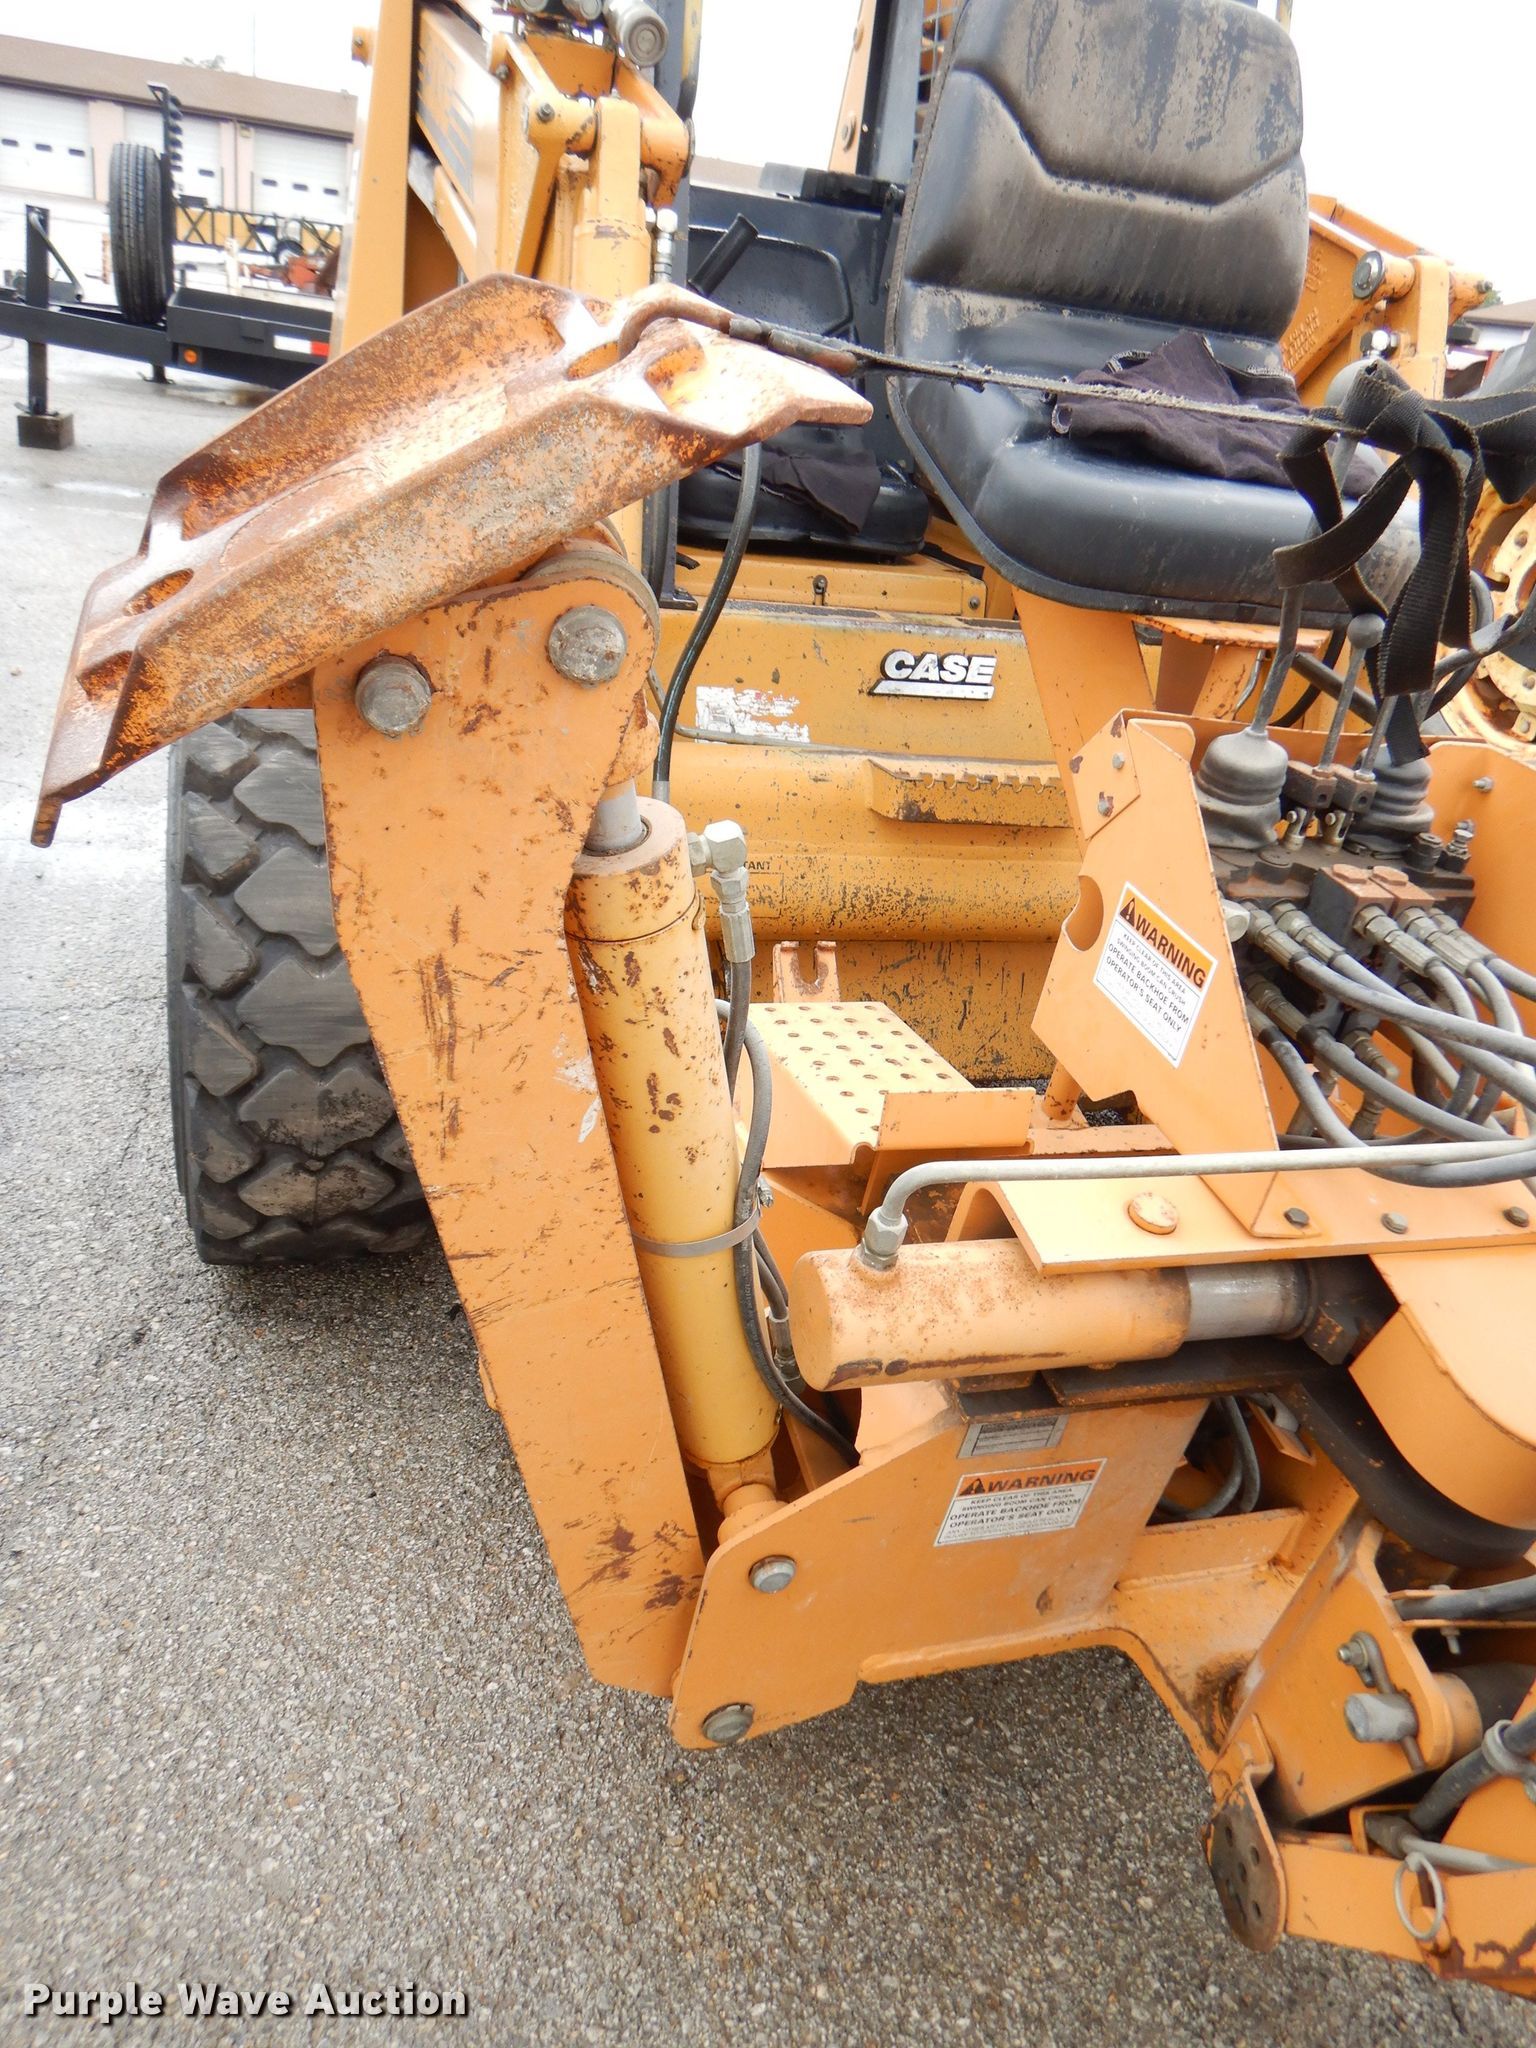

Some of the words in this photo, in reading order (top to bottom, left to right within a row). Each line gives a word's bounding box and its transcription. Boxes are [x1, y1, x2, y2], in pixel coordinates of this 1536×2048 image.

[882, 649, 997, 685] CASE
[1123, 933, 1136, 946] KEEP
[1135, 913, 1207, 989] WARNING
[1106, 956, 1144, 997] OPERATOR'S
[1144, 994, 1162, 1013] SEAT
[1108, 943, 1136, 974] OPERATE
[1136, 970, 1168, 1005] BACKHOE
[1169, 1002, 1189, 1025] FROM
[987, 1469, 1096, 1493] WARNING
[950, 1509, 996, 1520] OPERATE
[1000, 1503, 1049, 1515] BACKHOE
[1053, 1498, 1082, 1507] FROM
[950, 1514, 1015, 1528] OPERATOR'S
[1018, 1510, 1044, 1519] SEAT
